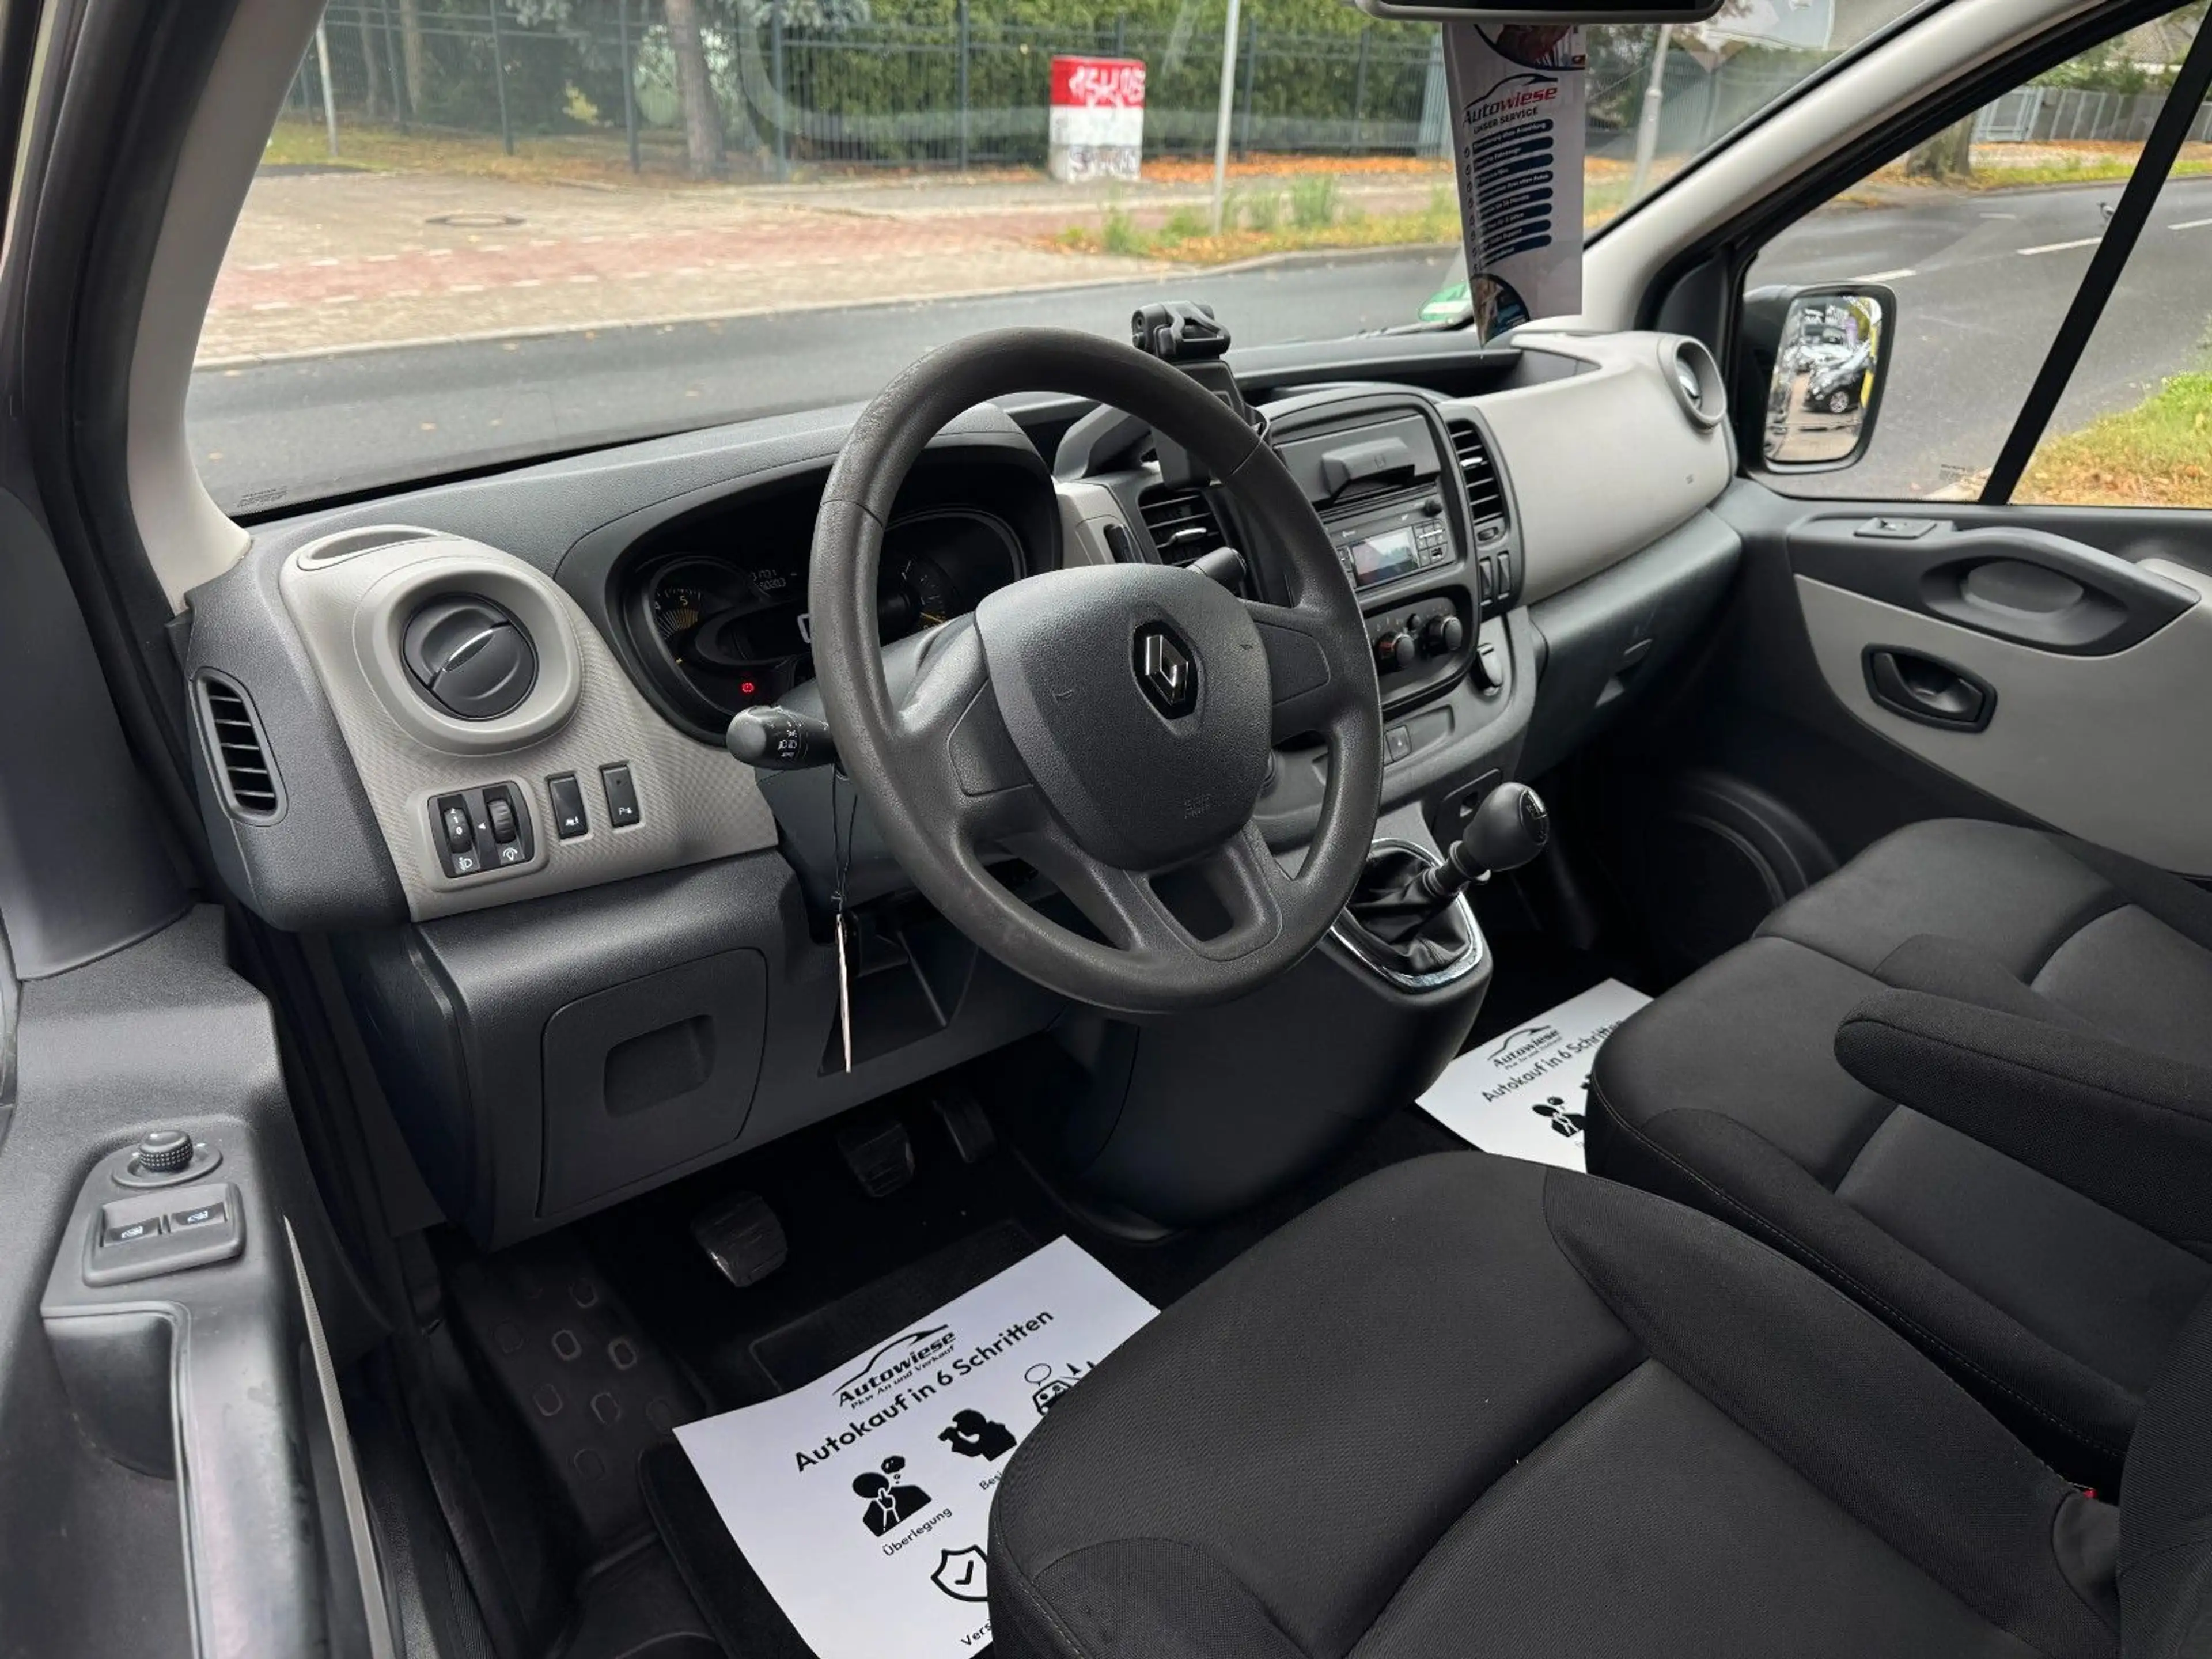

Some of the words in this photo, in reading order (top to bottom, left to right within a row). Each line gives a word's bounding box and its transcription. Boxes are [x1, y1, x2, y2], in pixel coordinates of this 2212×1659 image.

[1463, 88, 1558, 127] Autowiese
[1499, 107, 1539, 124] SERVICE
[1482, 1062, 1548, 1103] Autokauf
[1541, 1057, 1563, 1069] in
[1557, 1049, 1571, 1059] 6
[795, 1393, 910, 1472] Autokauf
[907, 1385, 937, 1403] in
[937, 1369, 953, 1386] 6
[952, 1310, 1054, 1376] Schritten
[839, 1331, 956, 1407] Autowiese
[851, 1394, 874, 1410] Pkw
[877, 1384, 892, 1395] An
[893, 1370, 913, 1385] und
[915, 1344, 955, 1372] Verkauf
[882, 1507, 953, 1557] Überlegung
